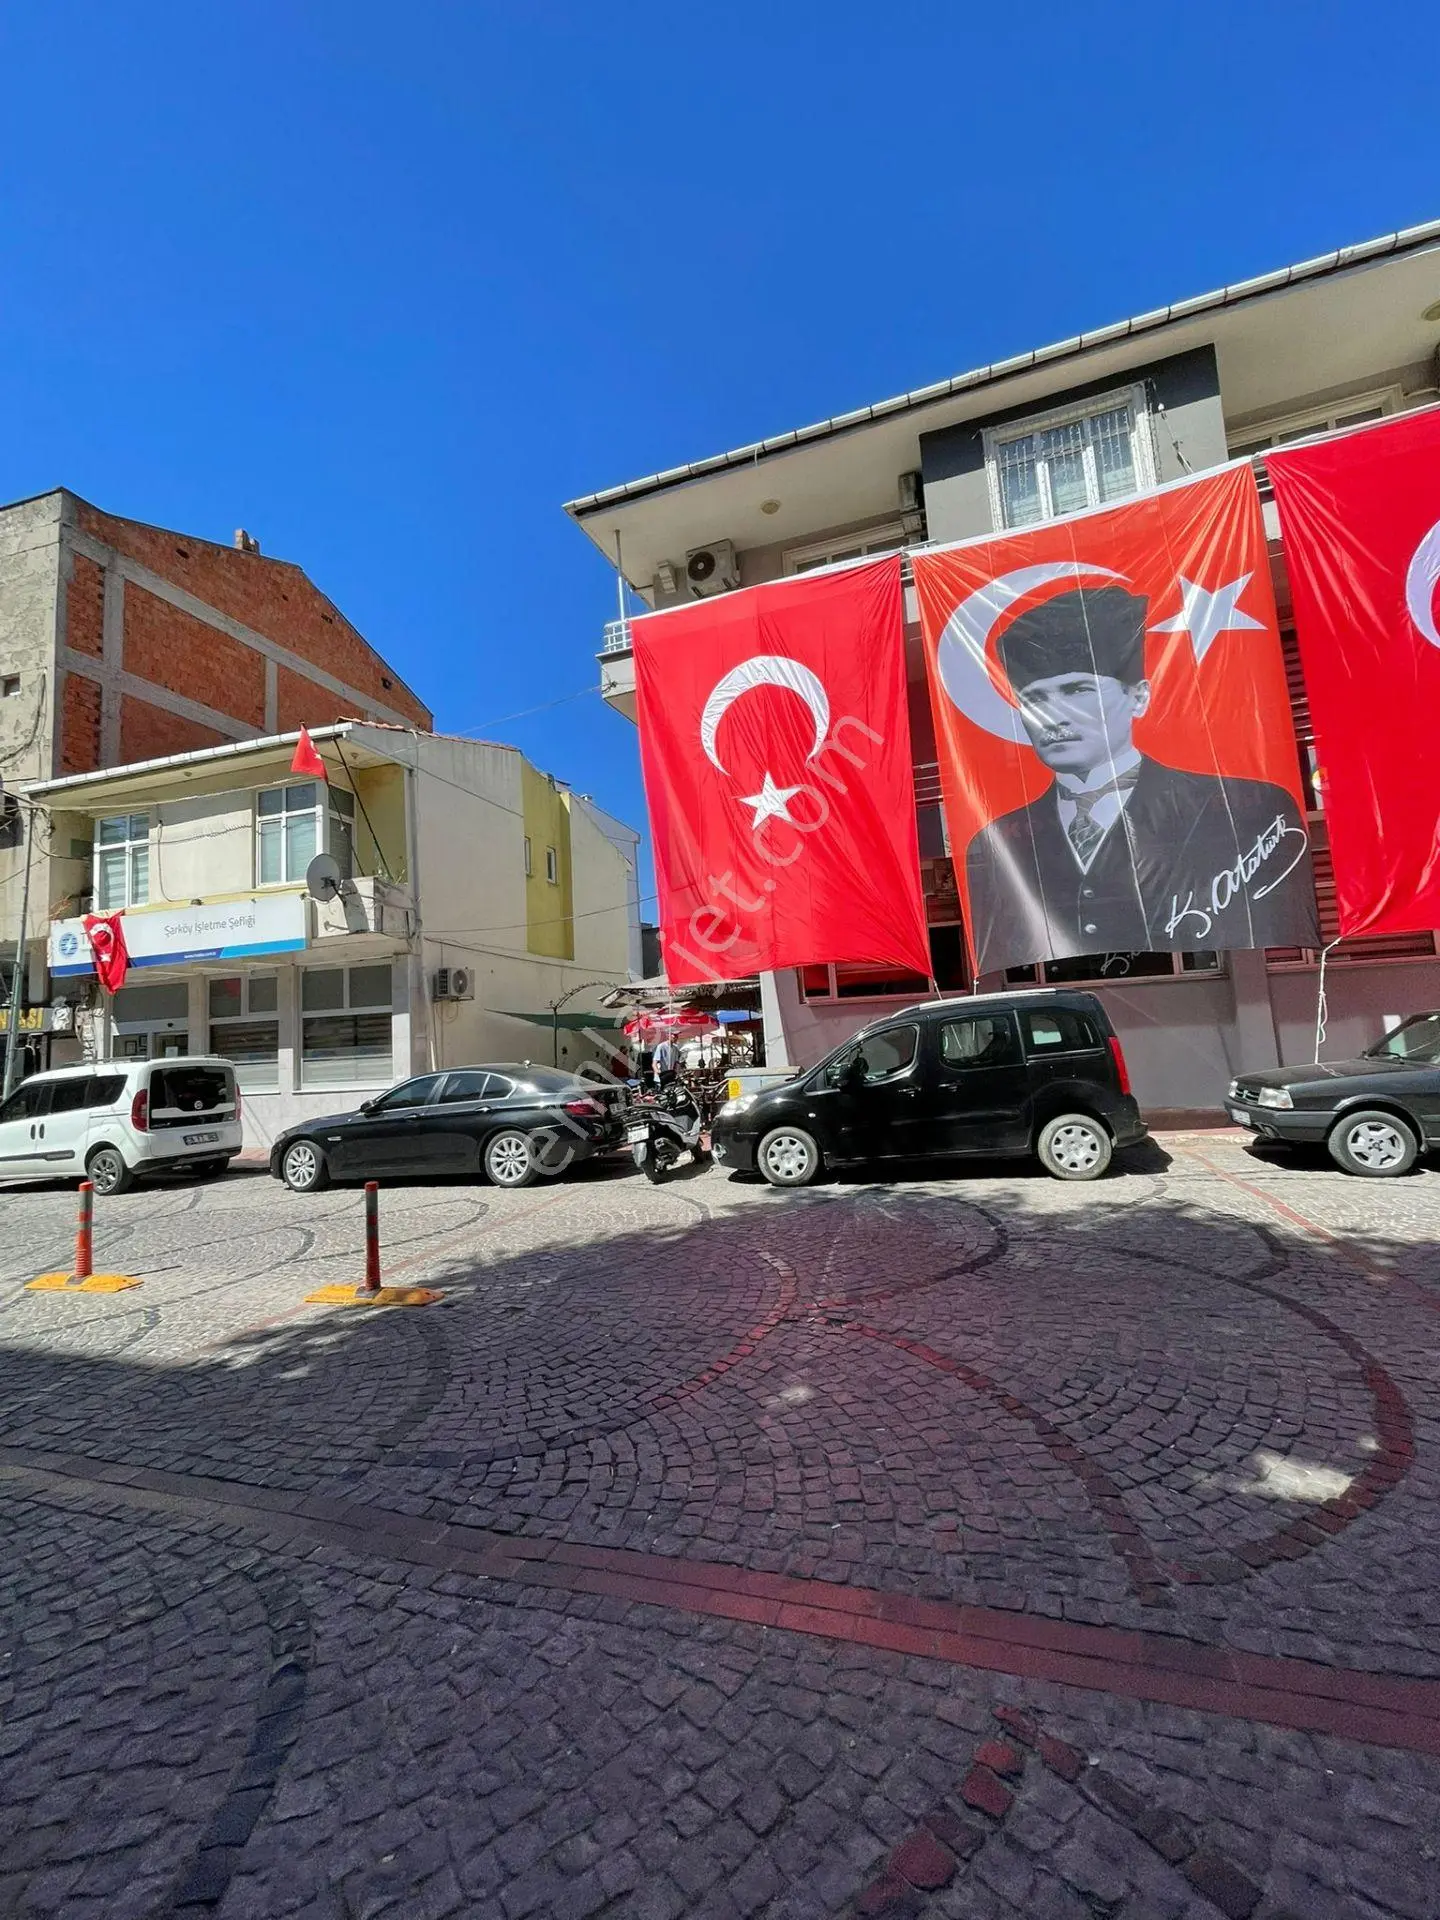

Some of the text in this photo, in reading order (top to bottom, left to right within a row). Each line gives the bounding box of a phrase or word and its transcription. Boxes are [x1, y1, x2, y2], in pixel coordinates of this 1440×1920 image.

[163, 914, 256, 938] Şarköy İşletme Şefliği
